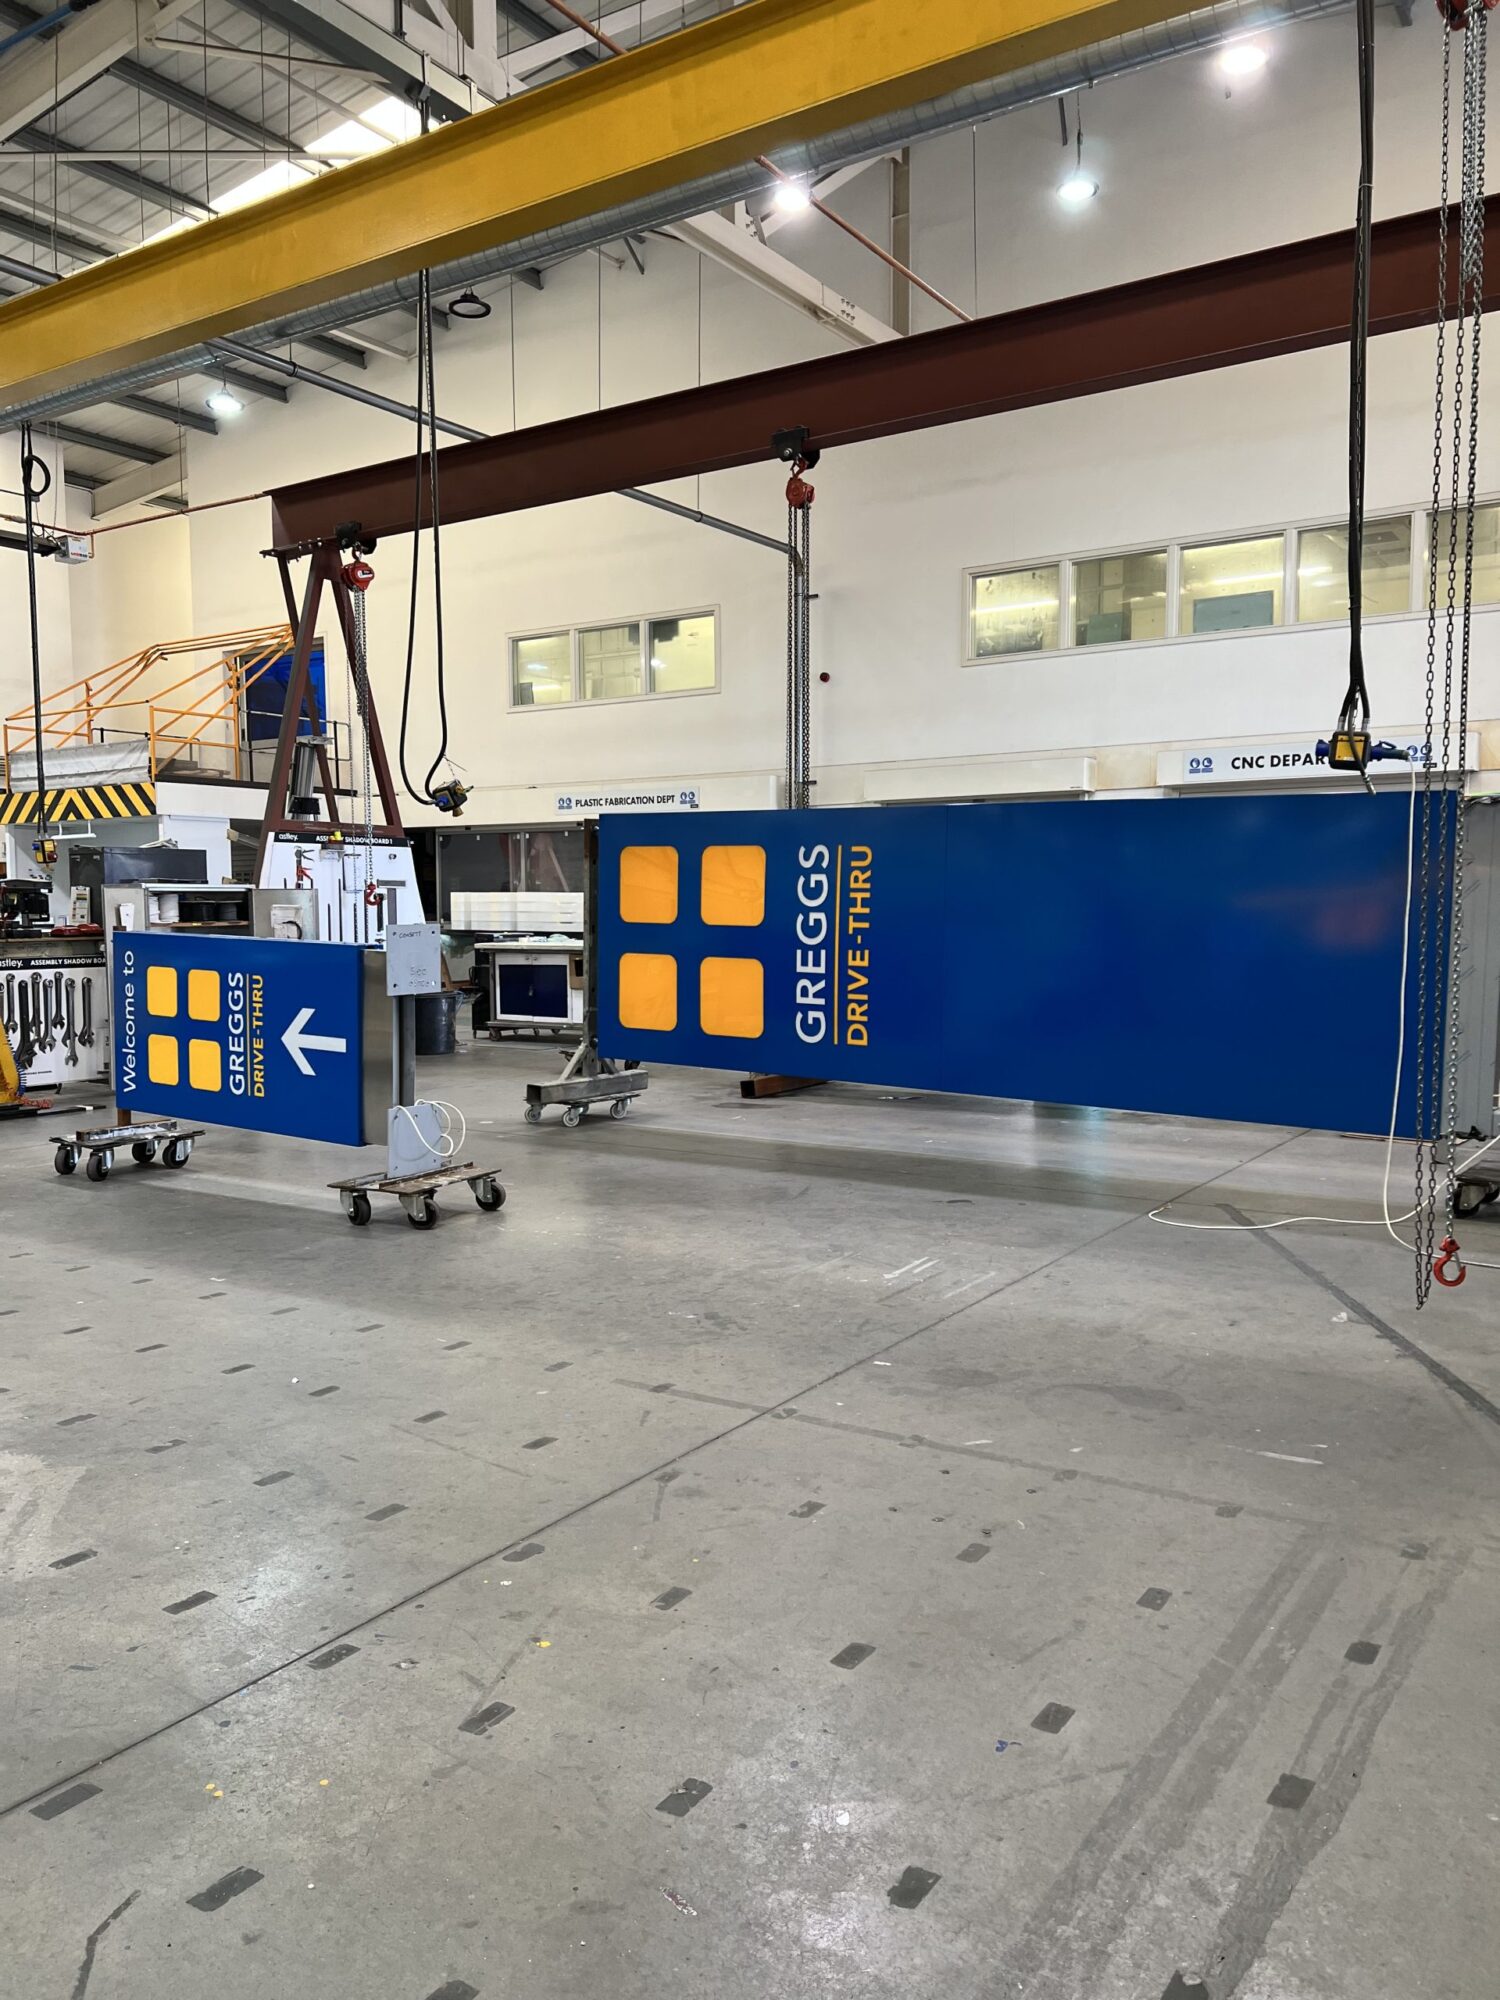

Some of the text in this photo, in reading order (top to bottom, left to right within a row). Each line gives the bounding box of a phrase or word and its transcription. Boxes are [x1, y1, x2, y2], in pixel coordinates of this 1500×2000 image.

[575, 794, 675, 807] PLASTIC FABRICATION DEPT
[1231, 753, 1326, 769] CNC DEPAR
[30, 958, 62, 966] ASSEMBLY
[63, 957, 92, 965] SHADOW
[795, 844, 830, 1044] GREGGS
[846, 845, 873, 1046] DRIVE-THRU
[122, 950, 137, 1092] Welcome to
[228, 972, 245, 1095] GREGGS
[252, 975, 265, 1098] DRIVE-THRU
